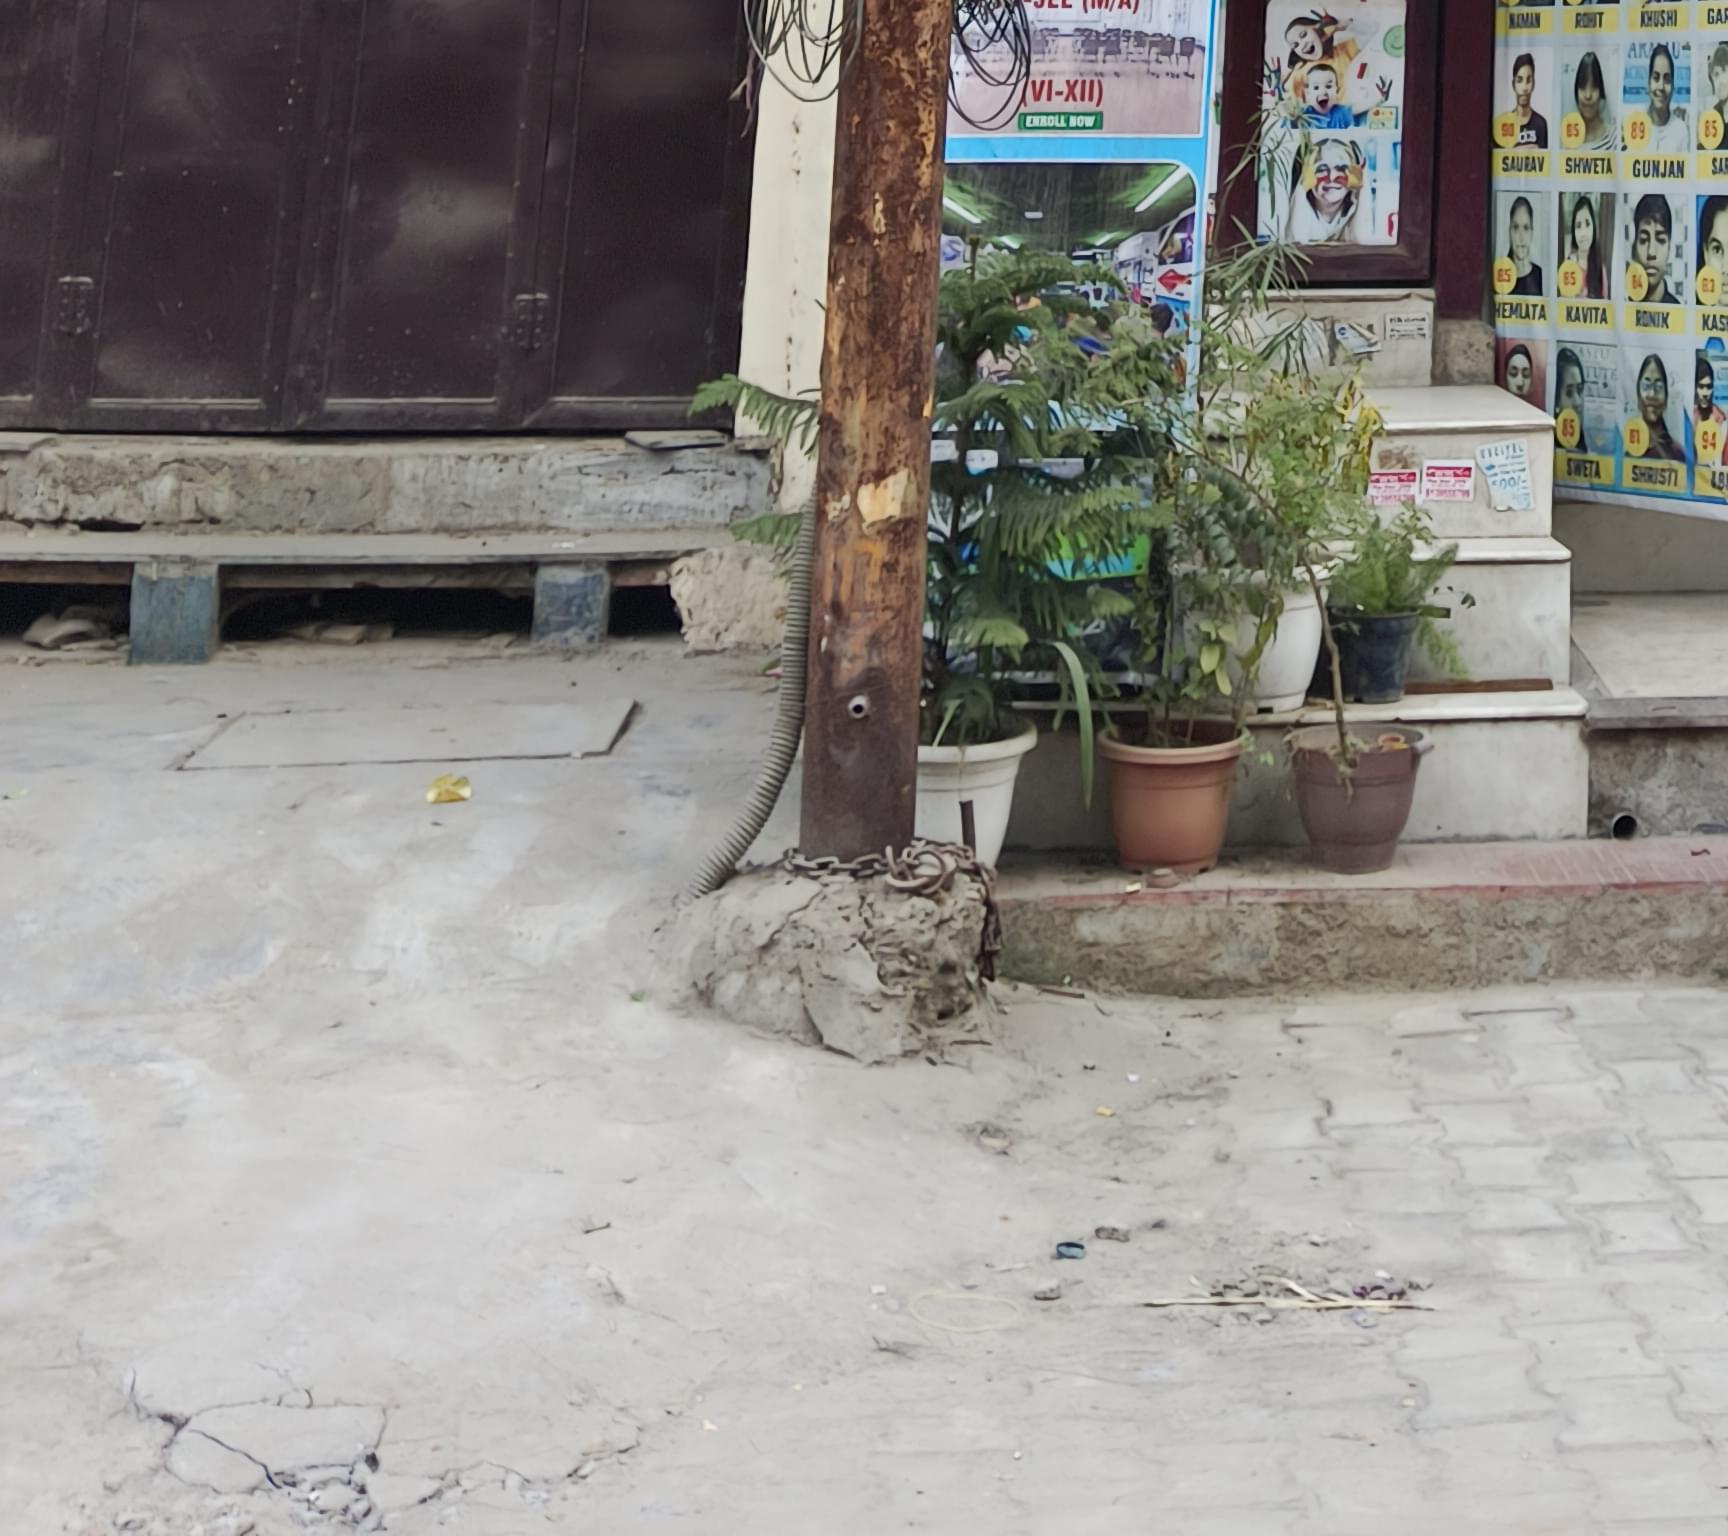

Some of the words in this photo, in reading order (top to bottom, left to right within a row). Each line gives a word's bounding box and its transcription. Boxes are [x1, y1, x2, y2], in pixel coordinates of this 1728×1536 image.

[1640, 9, 1678, 28] KHUSHI
[1022, 78, 1103, 108] (VI-XII)
[1024, 114, 1067, 129] ENROLL
[1069, 115, 1095, 129] NOW
[1565, 157, 1614, 175] SHWETA
[1632, 159, 1685, 179] GUNJAN
[1565, 305, 1609, 326] KAVITA
